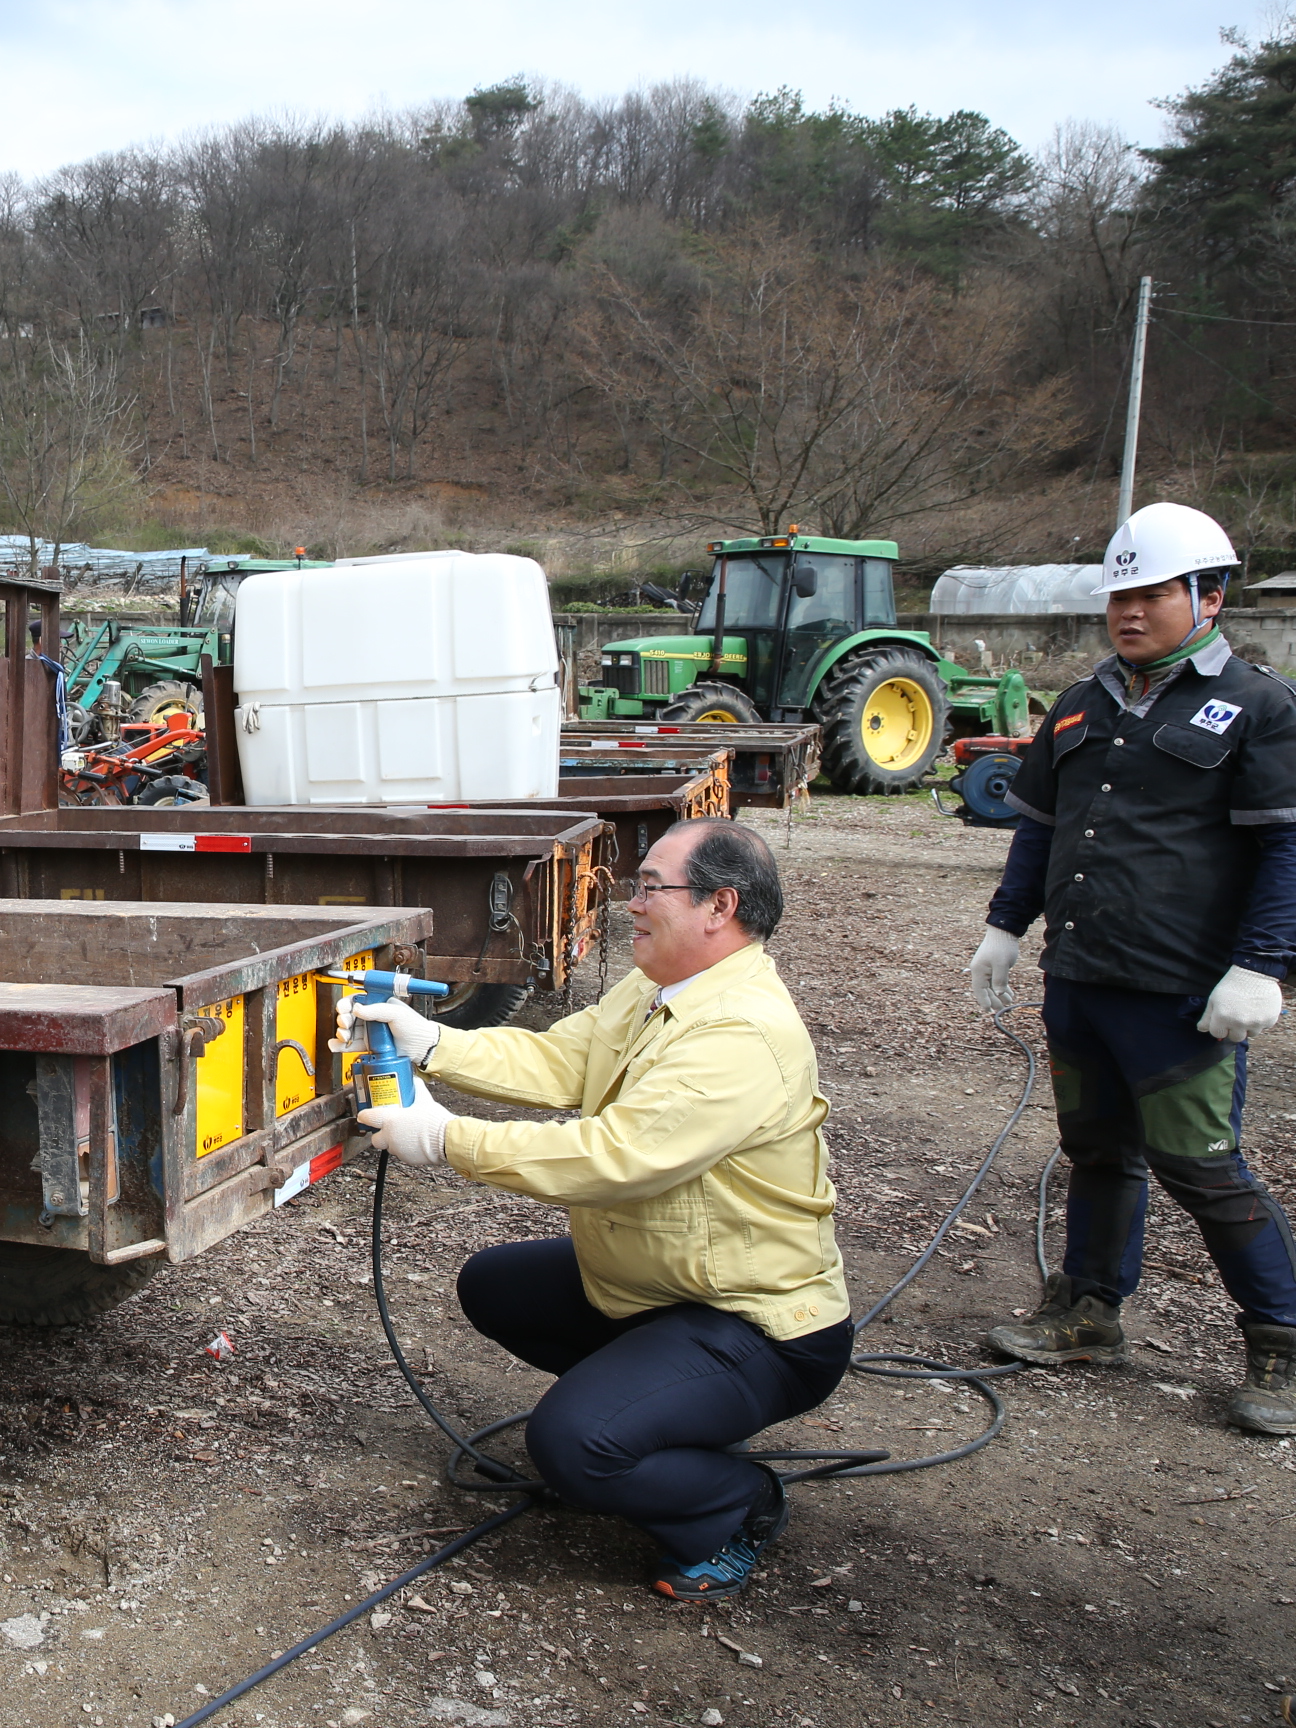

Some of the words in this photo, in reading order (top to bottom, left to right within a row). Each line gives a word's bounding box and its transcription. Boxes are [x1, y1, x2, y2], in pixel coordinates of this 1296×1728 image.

[1113, 566, 1139, 578] 무주군
[649, 649, 665, 657] 5410
[724, 653, 744, 661] DEERE
